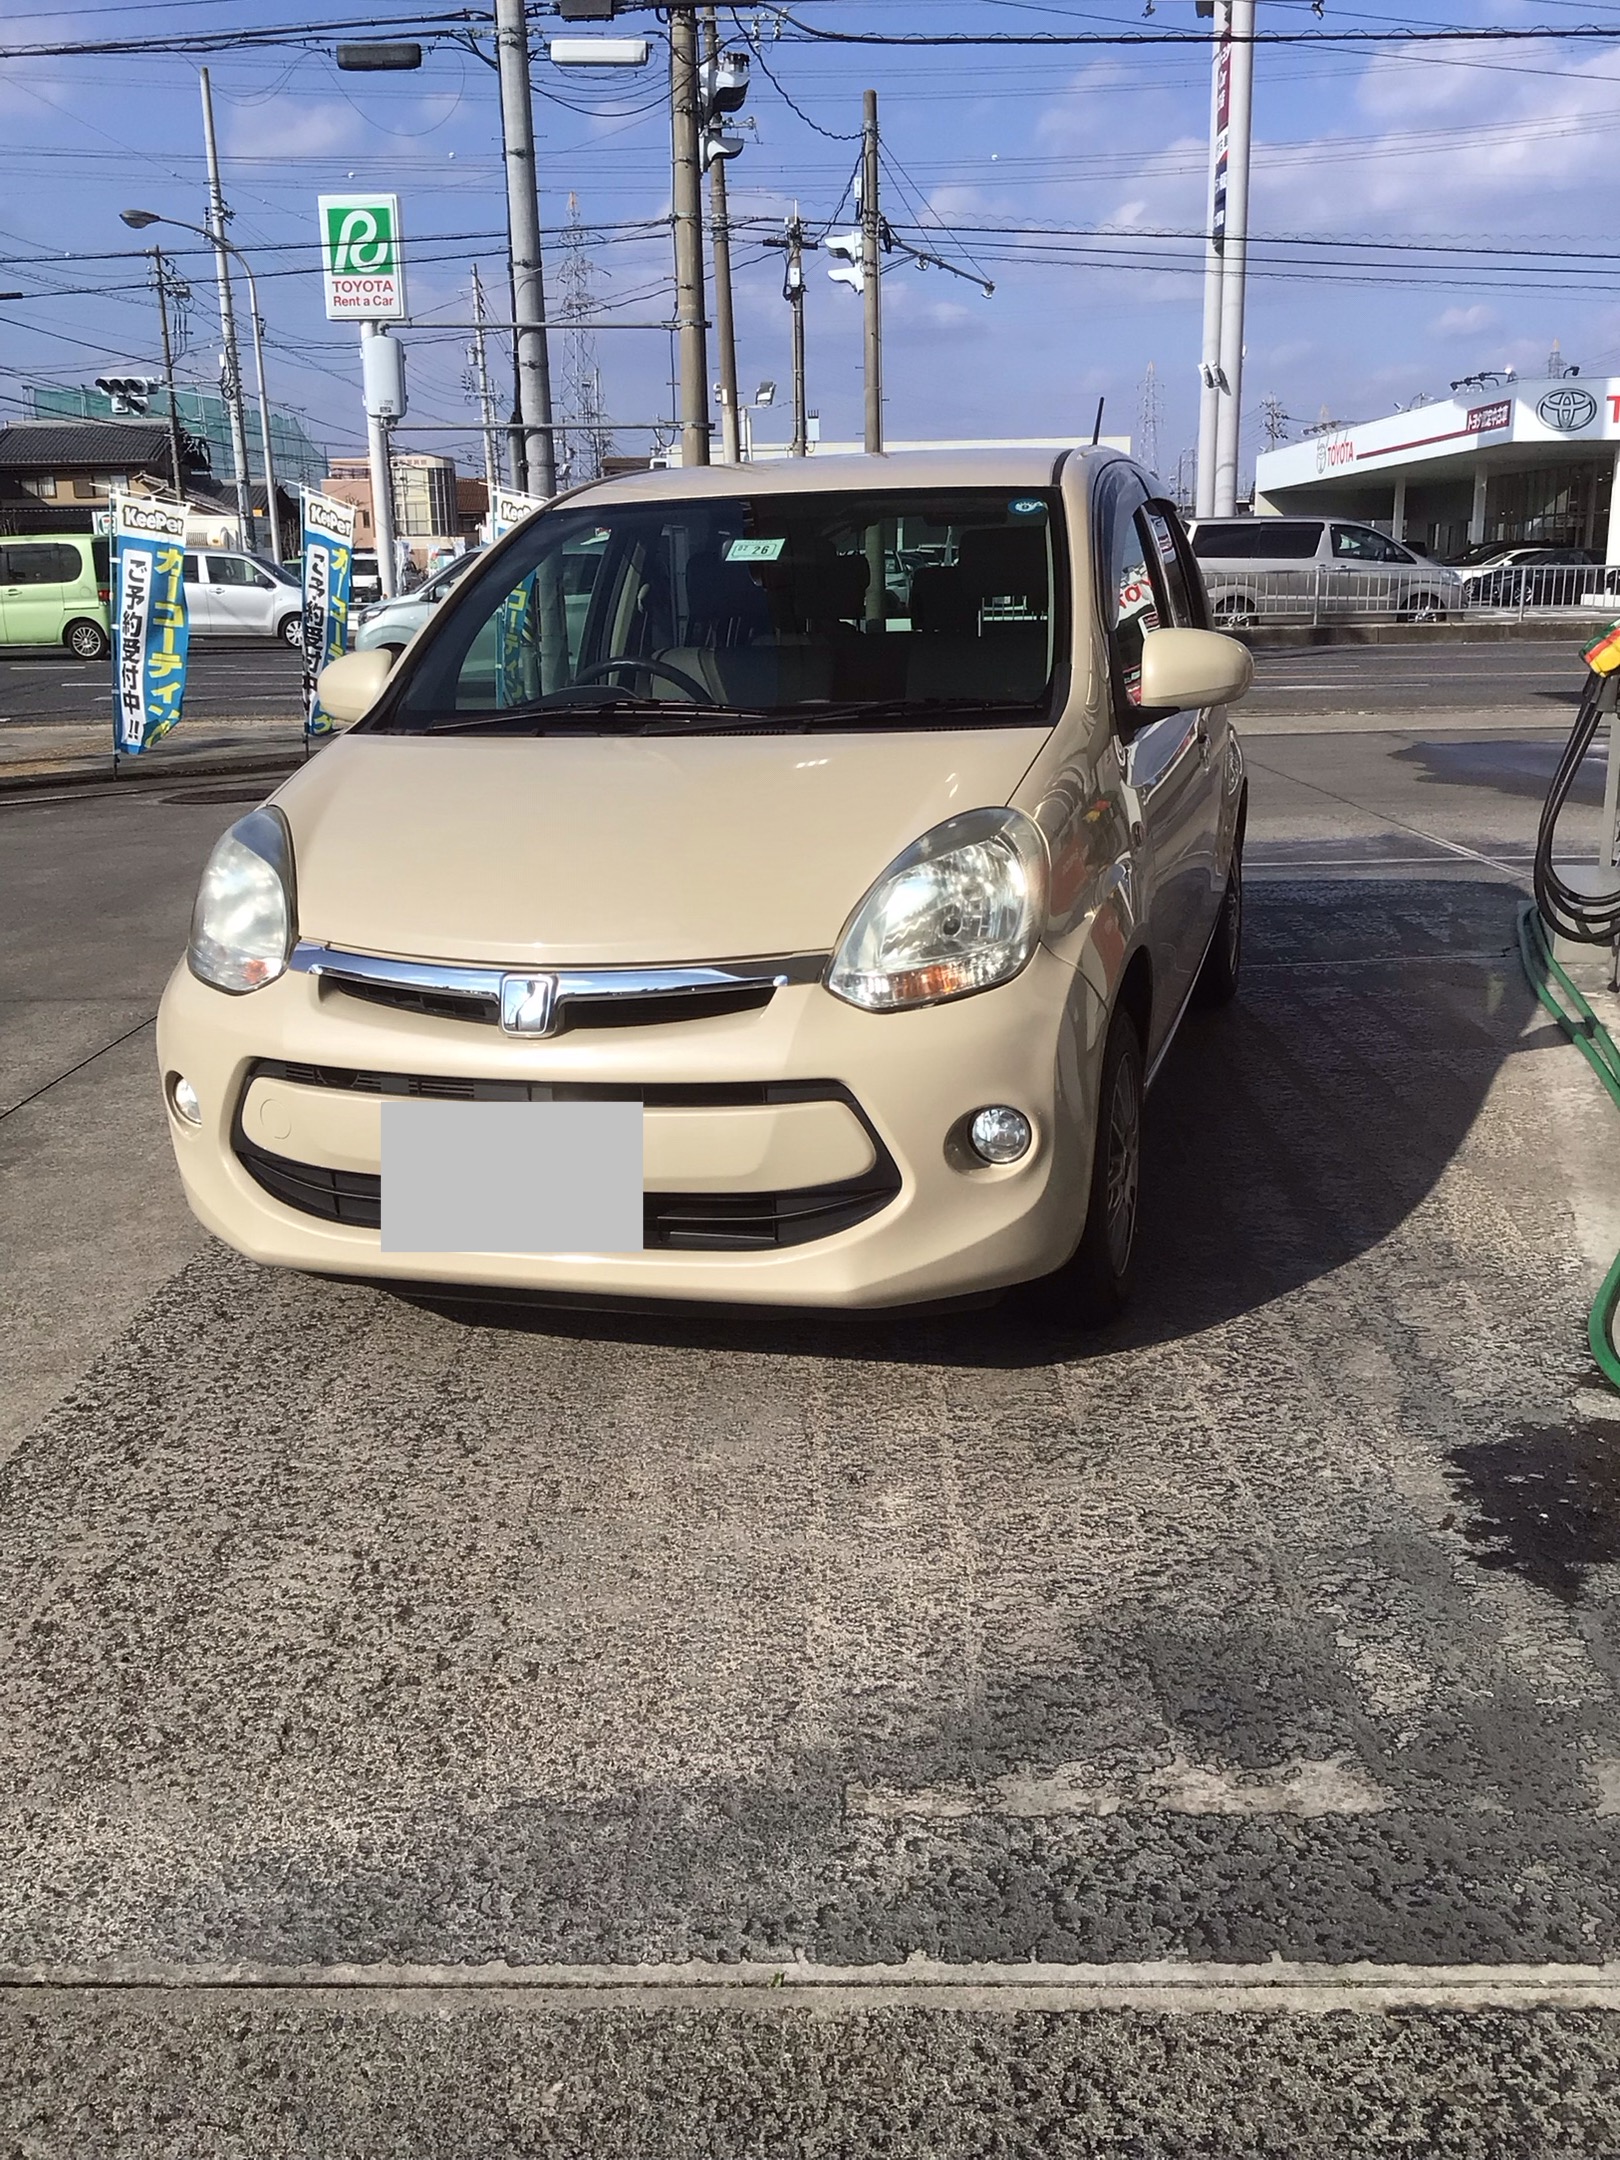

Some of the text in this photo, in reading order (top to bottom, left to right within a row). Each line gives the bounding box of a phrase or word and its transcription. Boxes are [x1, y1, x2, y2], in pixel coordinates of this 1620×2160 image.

[332, 280, 394, 292] TOYOTA
[333, 295, 394, 306] Rent a Car
[1327, 441, 1354, 467] TOYOTA
[123, 505, 184, 536] KeePer
[147, 548, 184, 749] カーコーティン
